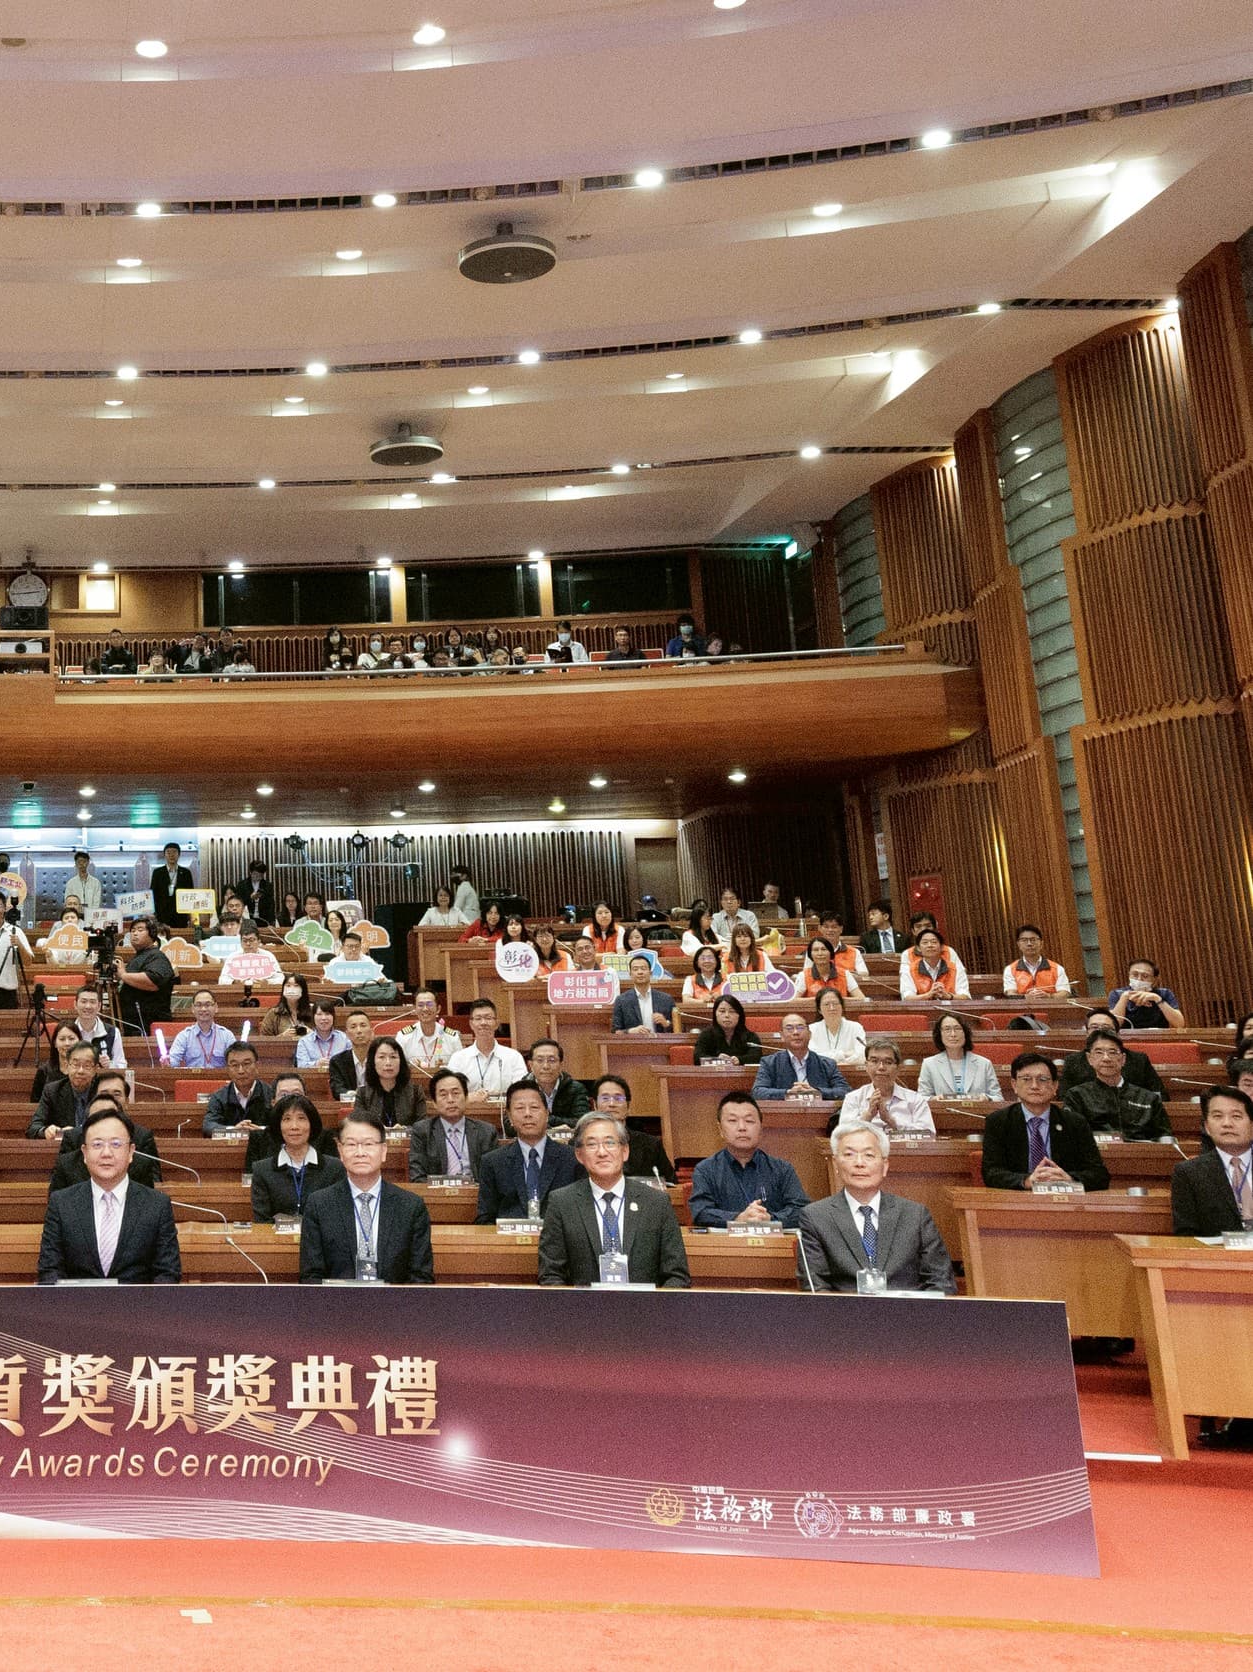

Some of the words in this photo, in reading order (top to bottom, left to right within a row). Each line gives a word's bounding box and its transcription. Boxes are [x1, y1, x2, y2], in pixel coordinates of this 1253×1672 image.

[564, 976, 597, 987] 彰化縣
[553, 988, 609, 999] 地方稅務局
[10, 1447, 145, 1477] Awards
[154, 1447, 334, 1486] Ceremony
[694, 1495, 773, 1529] 法務部
[846, 1504, 975, 1527] 法務部廉政署
